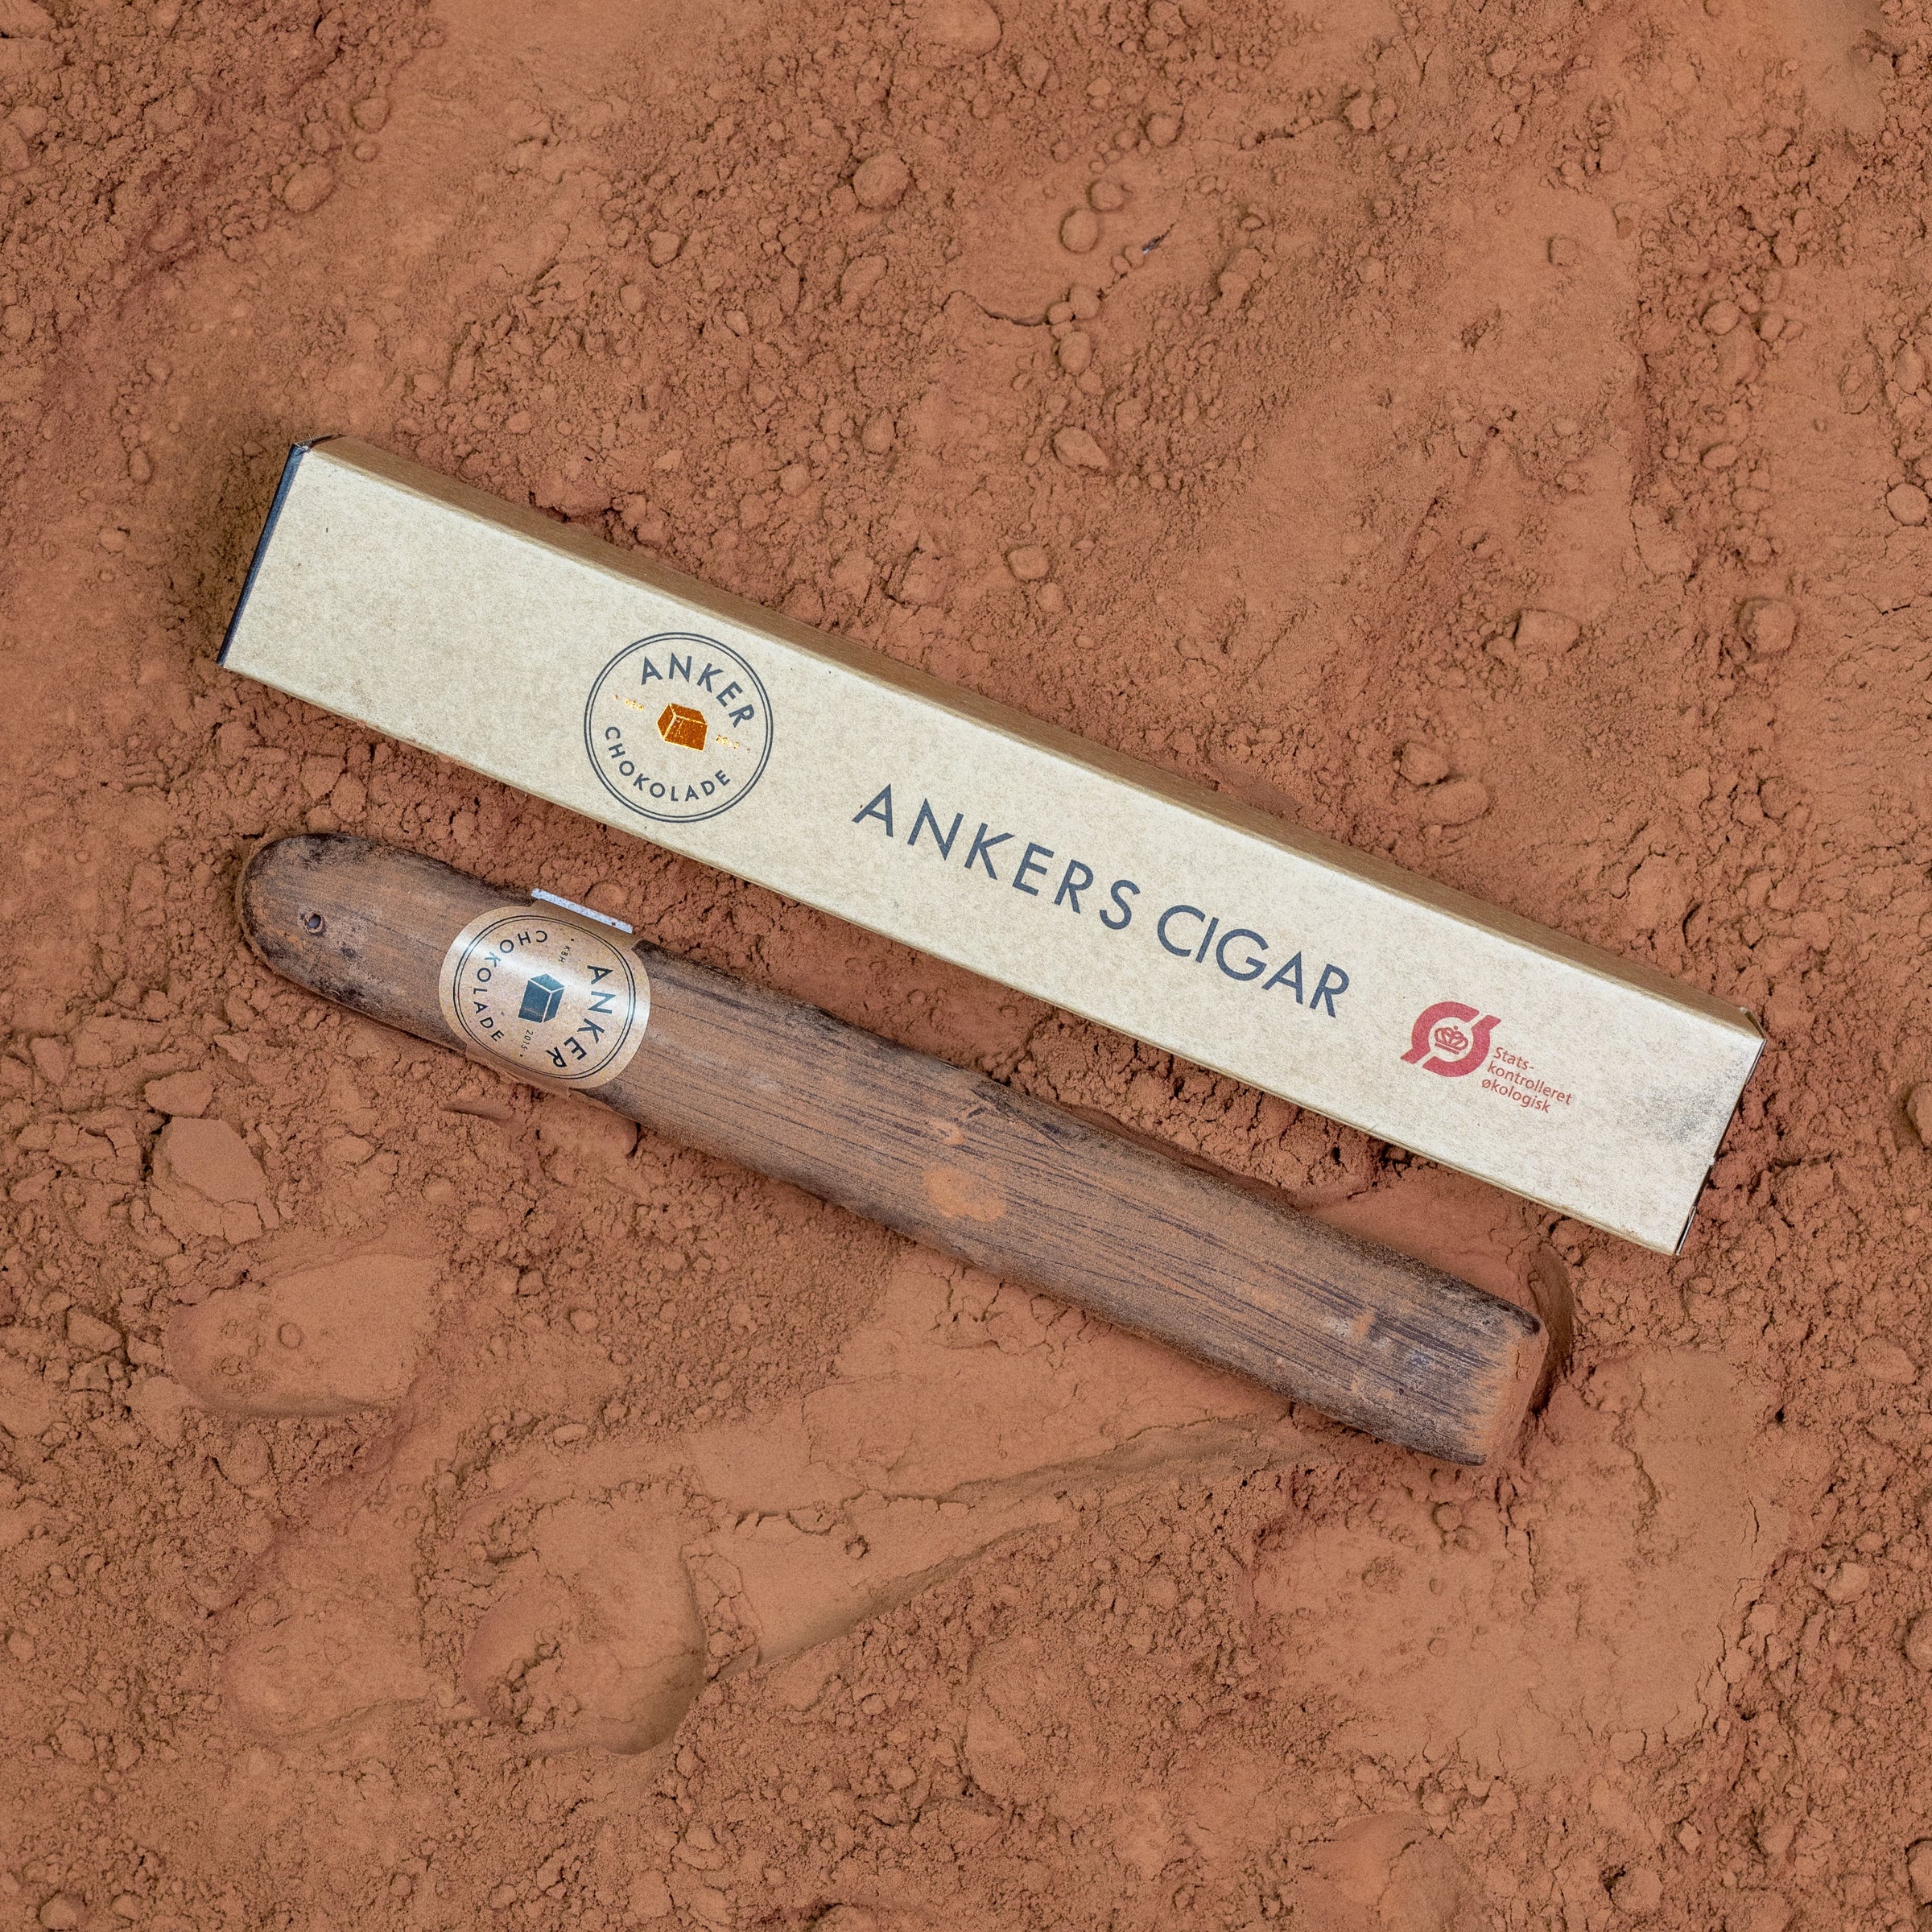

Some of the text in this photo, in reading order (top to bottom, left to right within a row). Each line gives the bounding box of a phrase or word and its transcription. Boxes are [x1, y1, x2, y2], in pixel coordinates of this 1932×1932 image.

[641, 651, 755, 729] ANKER
[605, 725, 731, 802] CHOKOLADE
[851, 782, 1350, 1018] ANKERS CIGAR
[473, 930, 548, 1042] CHOKOLADE
[545, 964, 617, 1068] ANKER
[1481, 1078, 1552, 1113] økologisk
[1487, 1060, 1573, 1105] kontrolleret
[1492, 1046, 1534, 1071] Stats-
